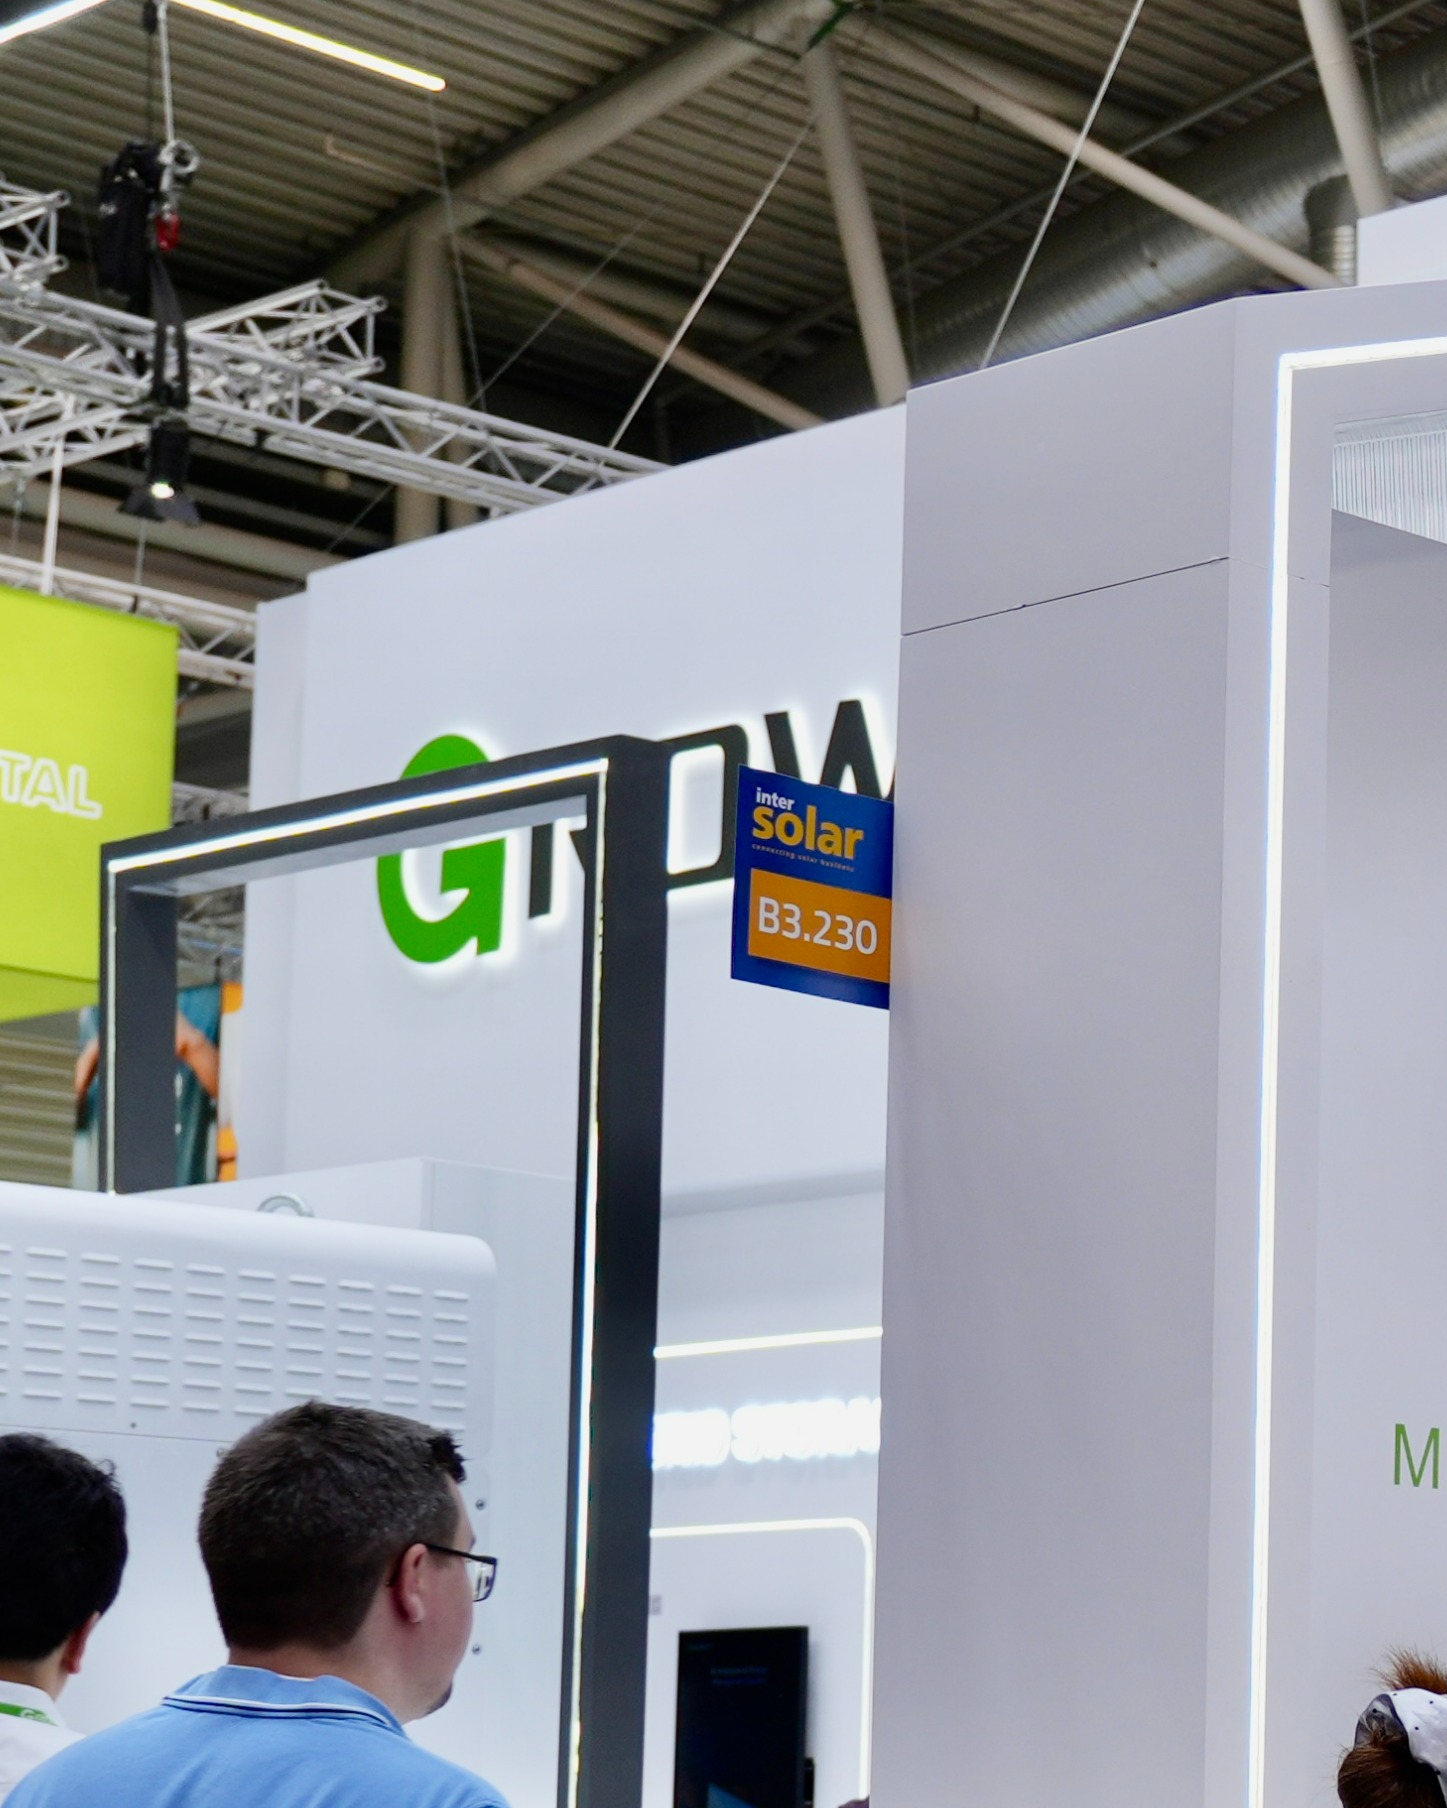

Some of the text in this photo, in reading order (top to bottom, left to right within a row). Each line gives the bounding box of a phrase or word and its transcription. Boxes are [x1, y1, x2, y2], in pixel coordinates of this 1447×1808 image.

[756, 787, 795, 811] inter
[752, 804, 865, 860] solar
[758, 896, 878, 955] B3.230
